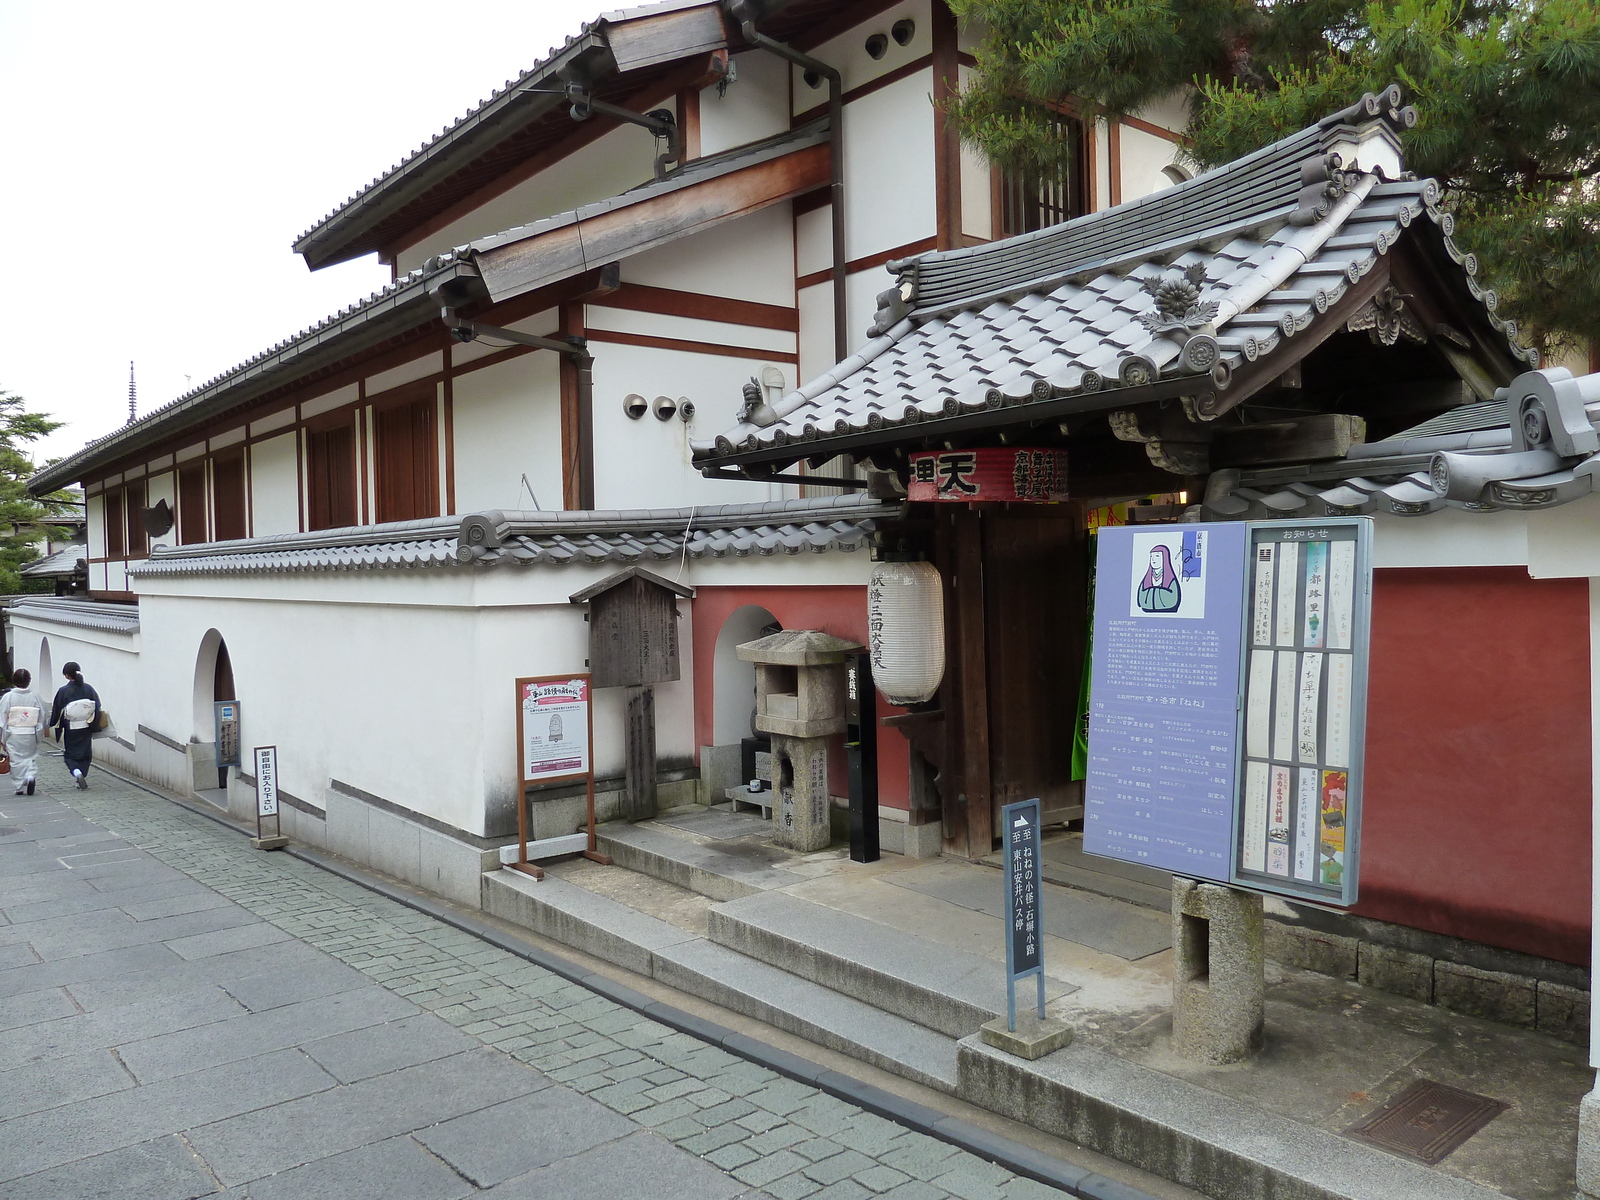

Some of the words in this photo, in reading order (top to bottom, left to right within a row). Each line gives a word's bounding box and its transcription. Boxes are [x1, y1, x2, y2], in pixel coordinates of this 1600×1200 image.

[1283, 529, 1328, 539] お知らせ
[1012, 832, 1022, 844] 至
[1022, 828, 1032, 840] 至
[1012, 849, 1024, 931] 東山安井バス停
